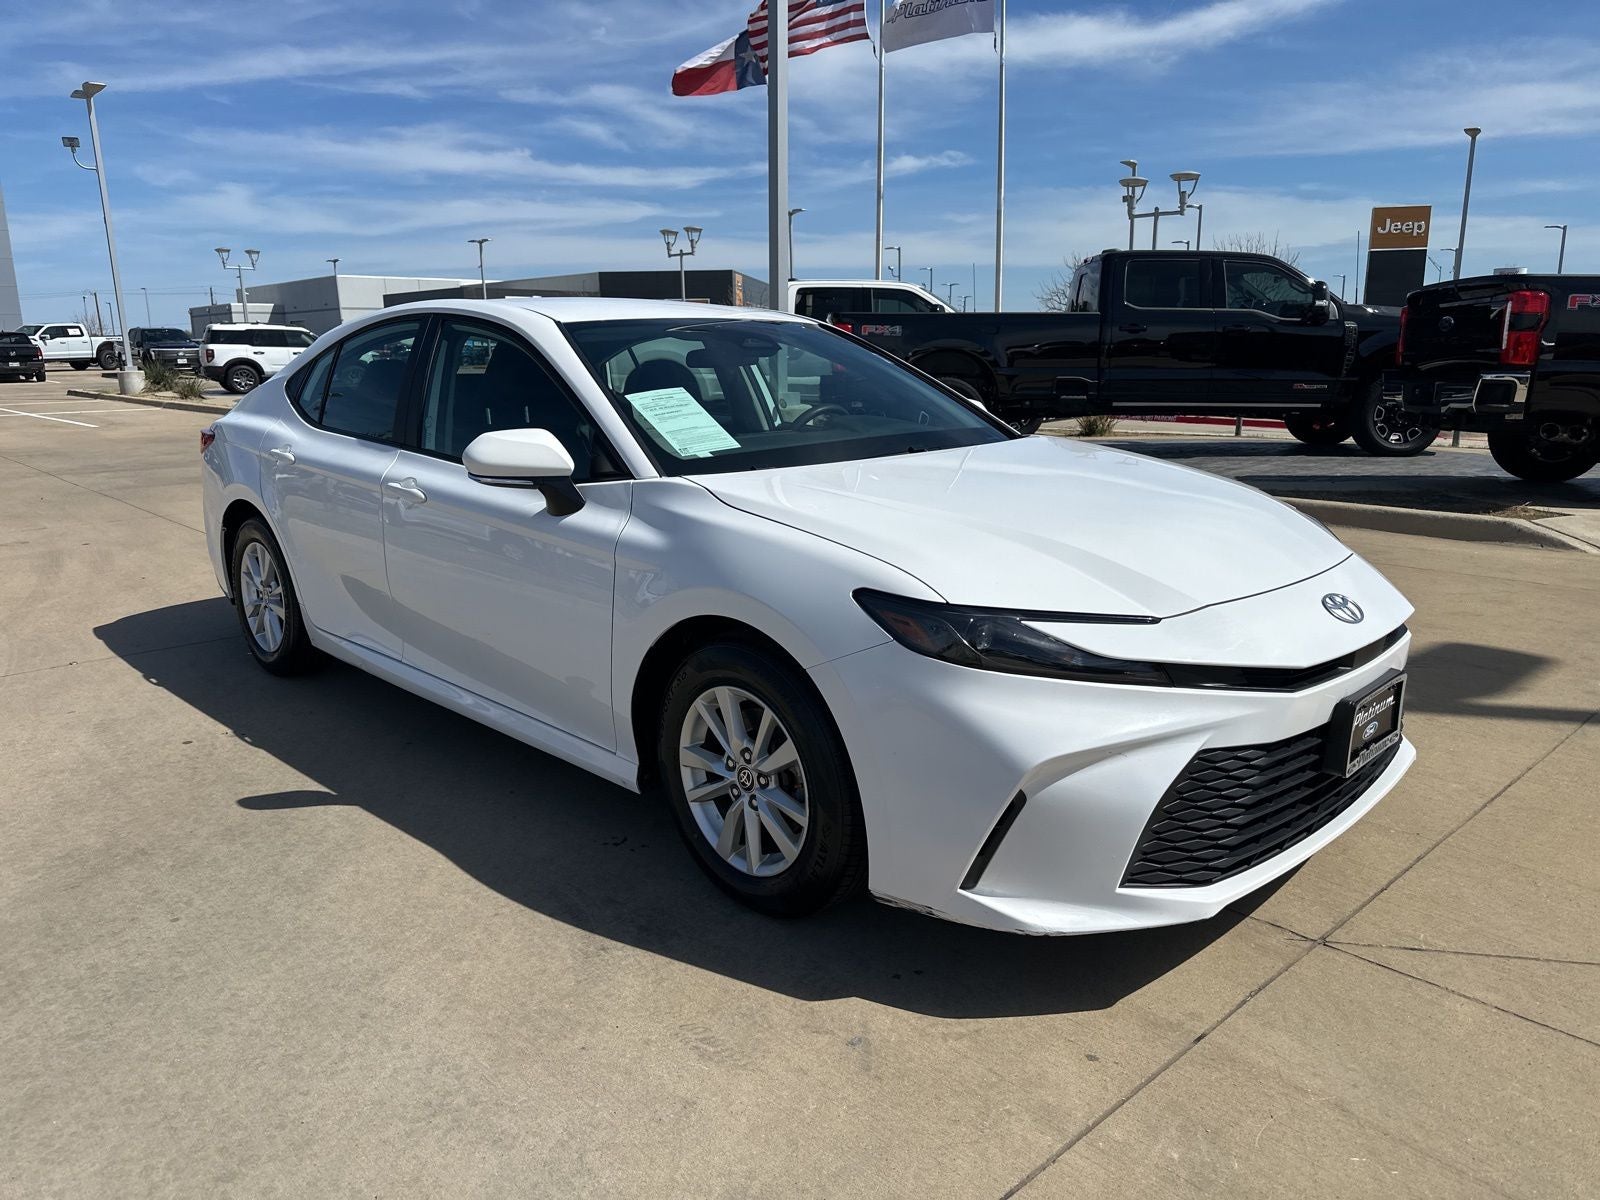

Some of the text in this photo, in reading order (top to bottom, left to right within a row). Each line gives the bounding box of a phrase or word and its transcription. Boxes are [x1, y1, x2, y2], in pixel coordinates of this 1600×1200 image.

[1377, 218, 1426, 237] Jeep
[861, 325, 903, 337] FX4
[1354, 695, 1396, 727] Platinum
